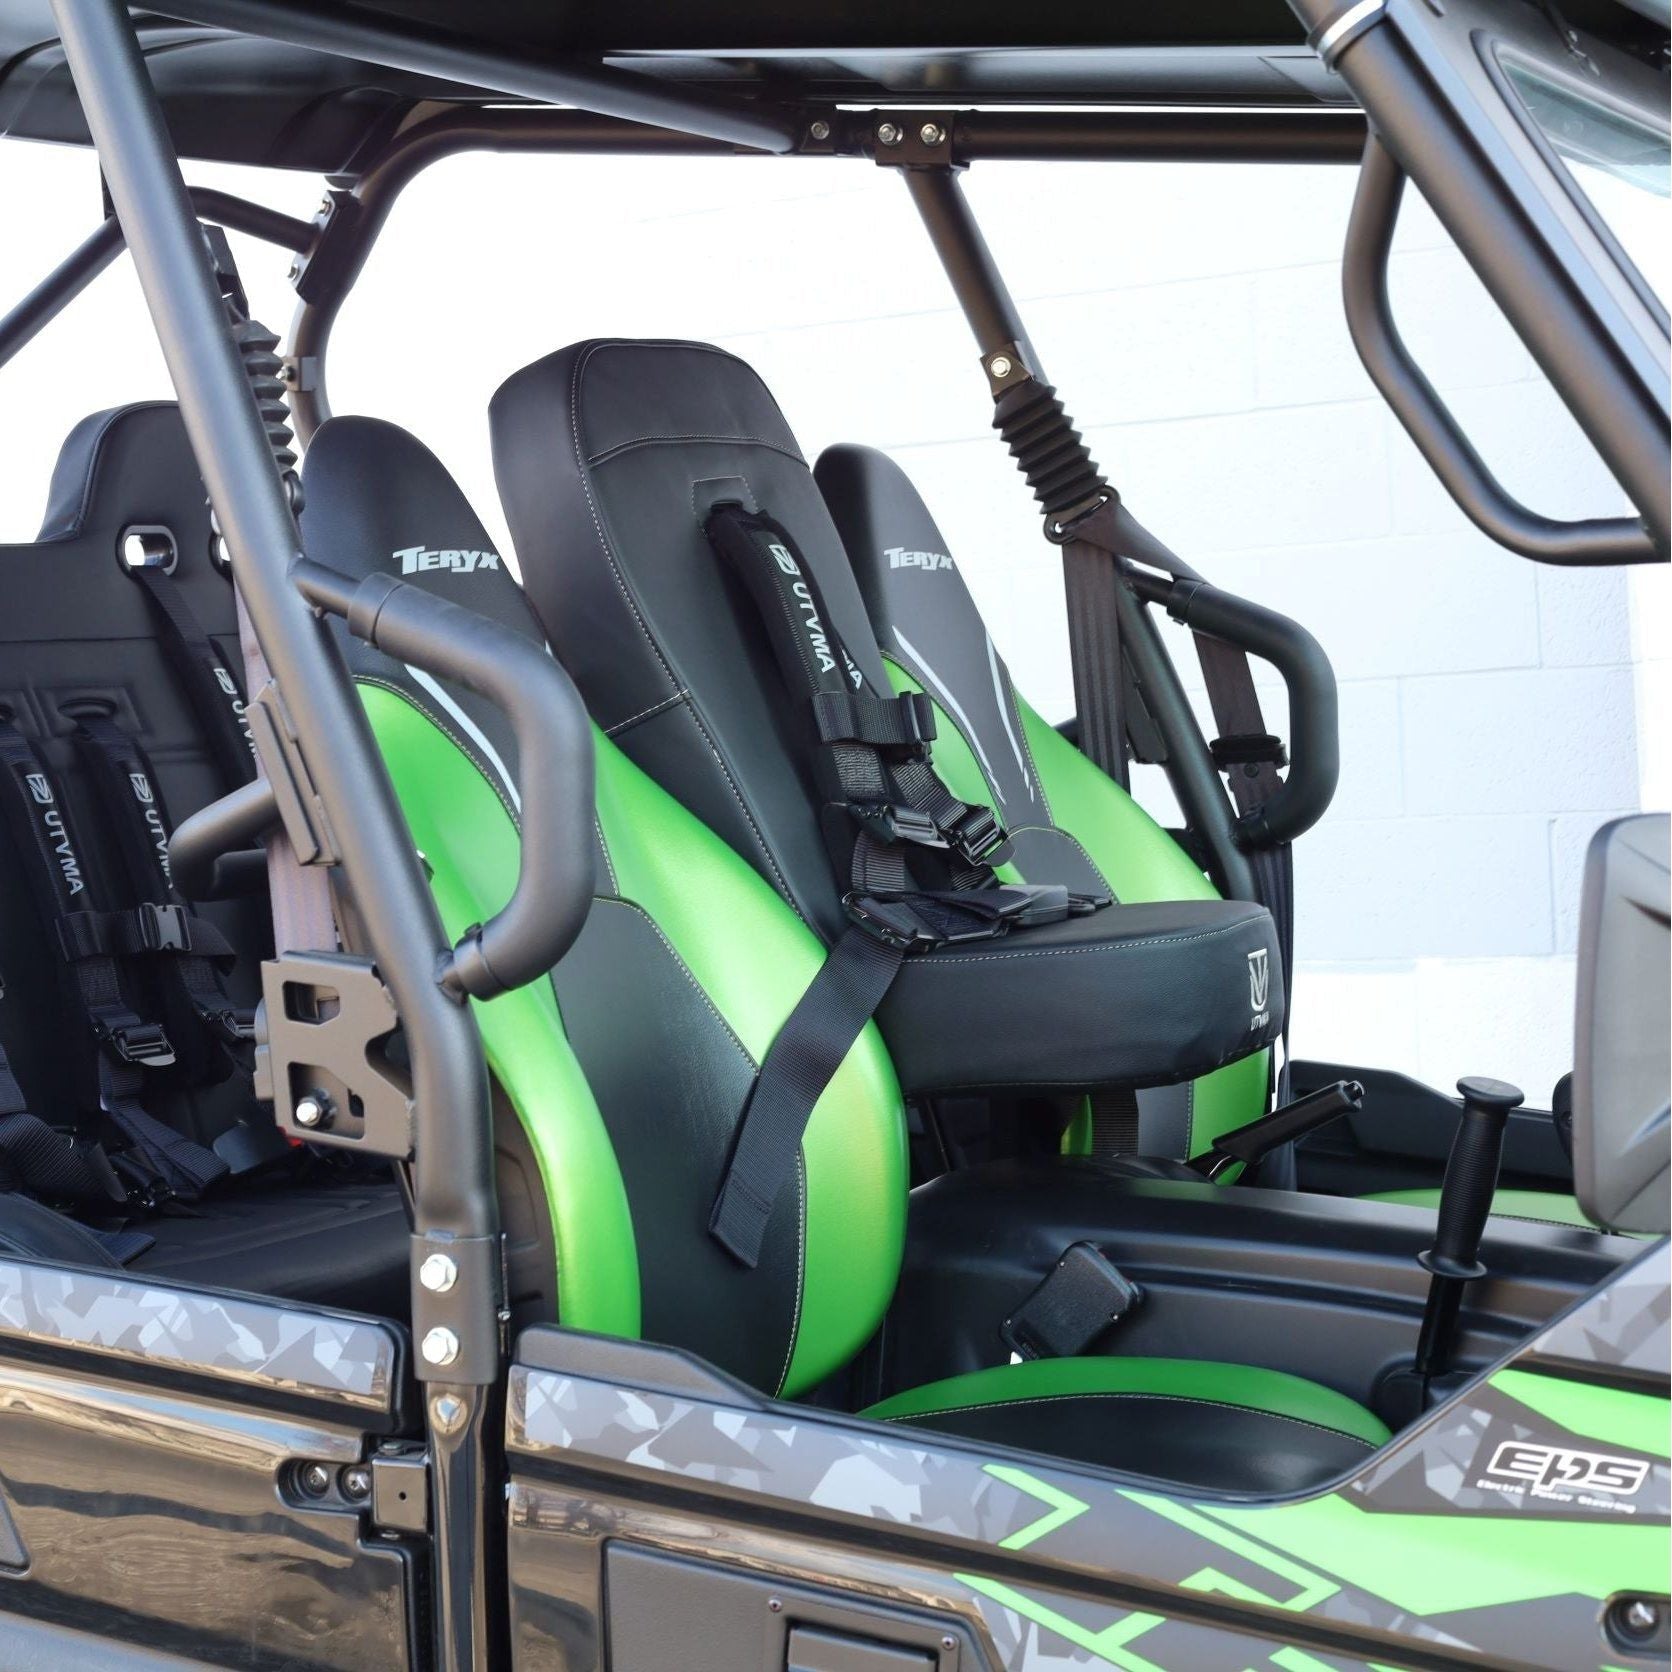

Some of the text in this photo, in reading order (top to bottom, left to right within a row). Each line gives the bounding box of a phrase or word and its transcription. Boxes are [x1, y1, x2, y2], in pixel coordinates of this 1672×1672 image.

[392, 545, 500, 575] TERYX
[792, 581, 836, 673] UTVMA
[44, 810, 84, 896] UTVMA
[145, 809, 174, 889] UTVM
[1489, 1443, 1648, 1493] EPS
